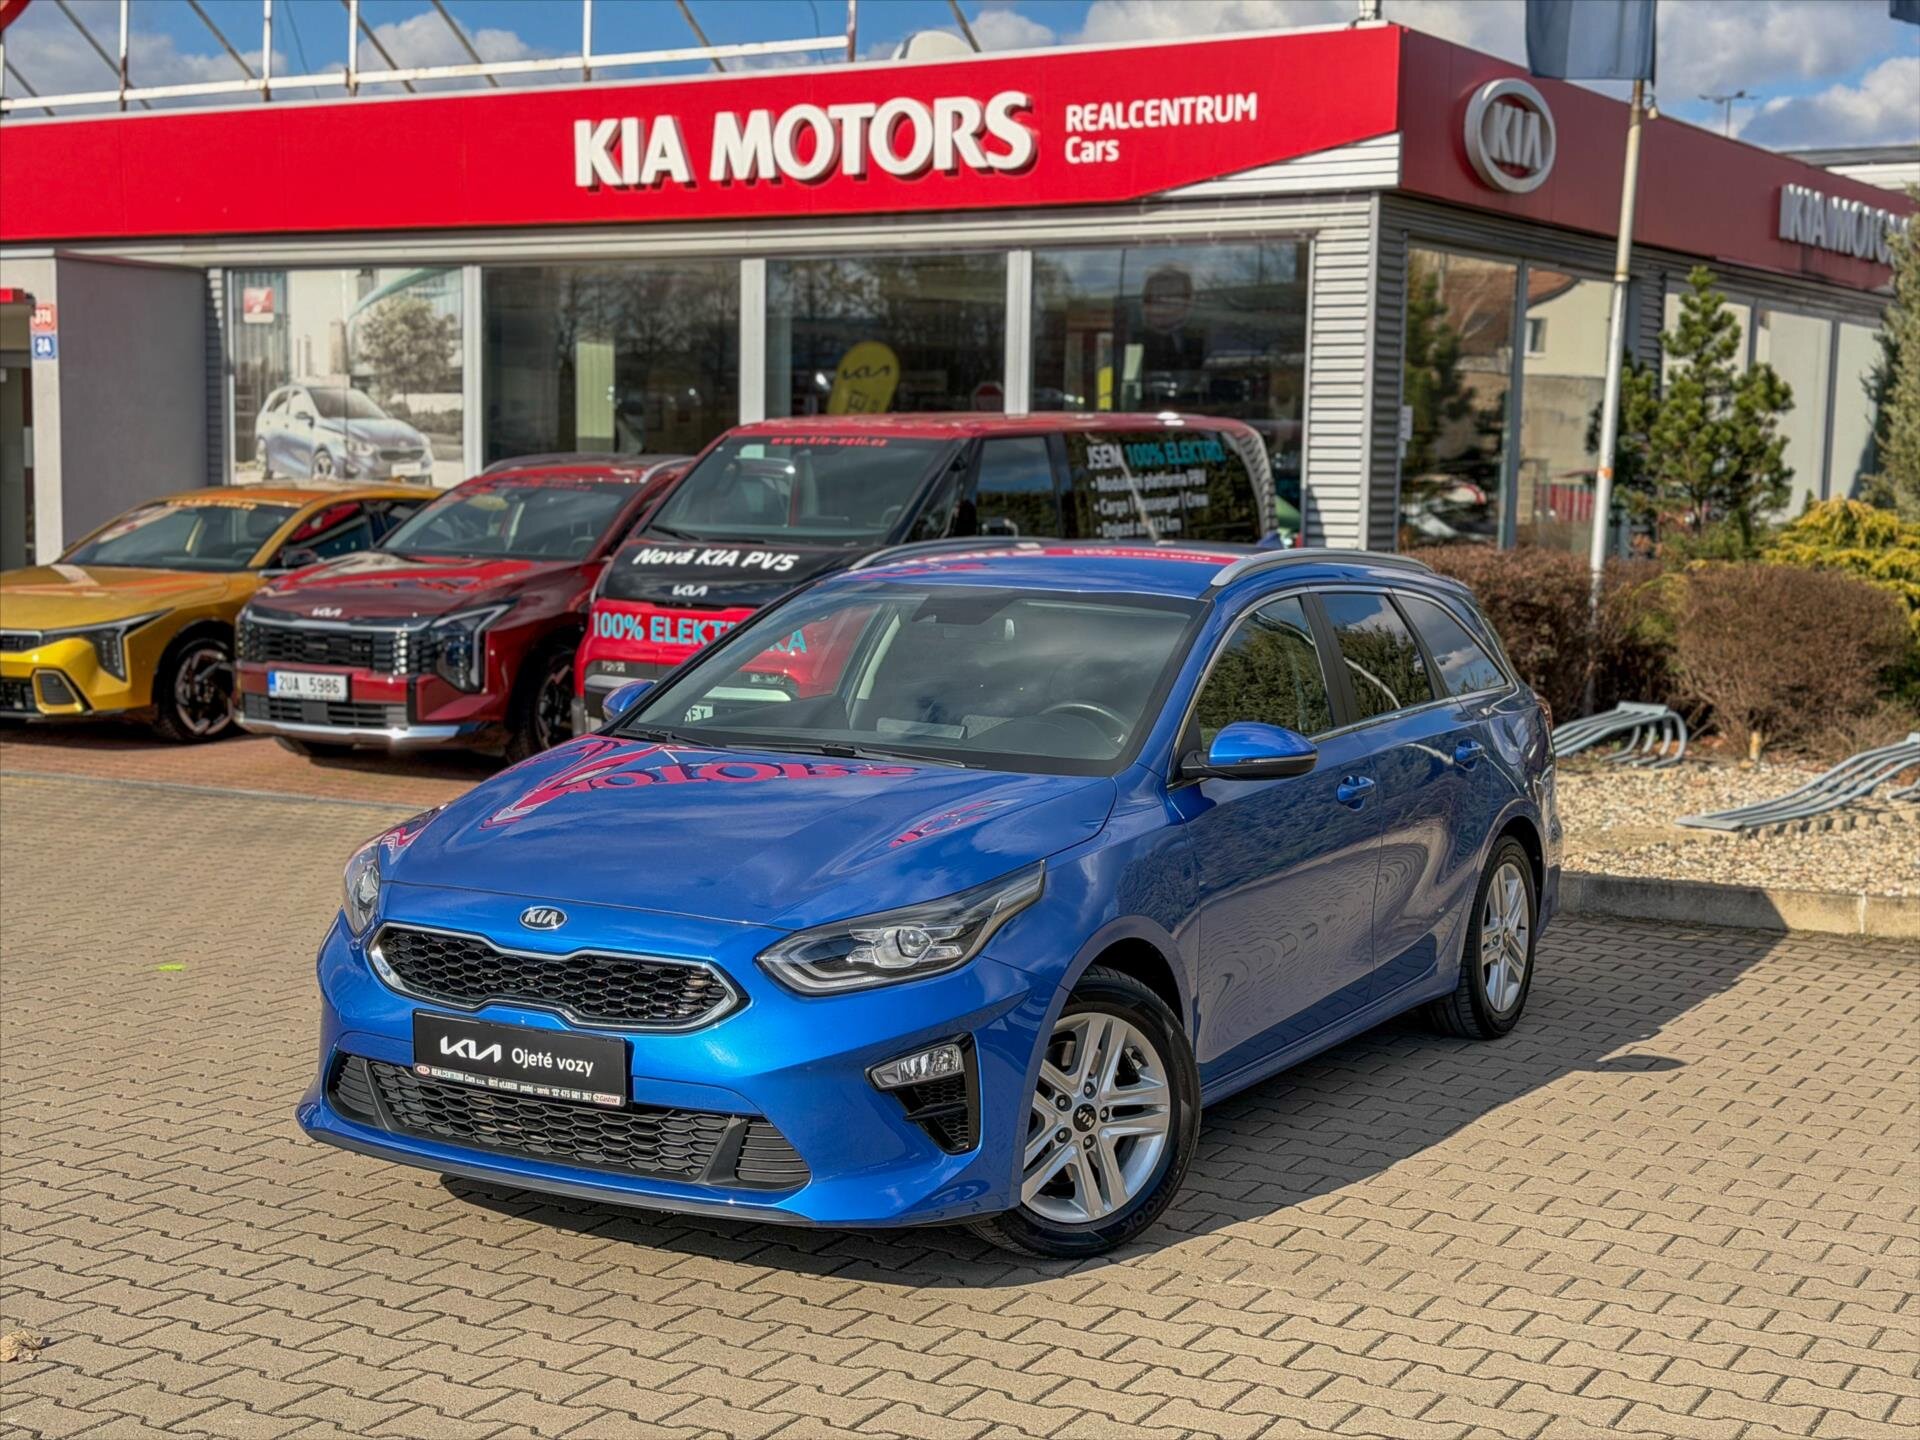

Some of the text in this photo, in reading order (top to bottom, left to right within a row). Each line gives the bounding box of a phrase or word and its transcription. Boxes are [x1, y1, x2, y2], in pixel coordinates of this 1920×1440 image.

[1065, 92, 1258, 133] REALCENTRUM
[574, 90, 1034, 187] KIA MOTORS
[1490, 101, 1542, 169] KIA
[1065, 136, 1120, 164] Cars
[1780, 183, 1826, 248] KIA
[37, 338, 51, 353] 2A
[1125, 442, 1165, 468] 100%
[632, 548, 799, 572] Nová KIA PV5
[592, 612, 644, 640] 100%
[279, 675, 340, 694] 2UA 5986
[524, 909, 558, 925] KIA
[439, 1035, 594, 1077] KIA Ojeté vozy
[431, 1067, 464, 1081] REALCENTRUM
[465, 1073, 475, 1084] Cars
[1077, 1108, 1095, 1128] KIA
